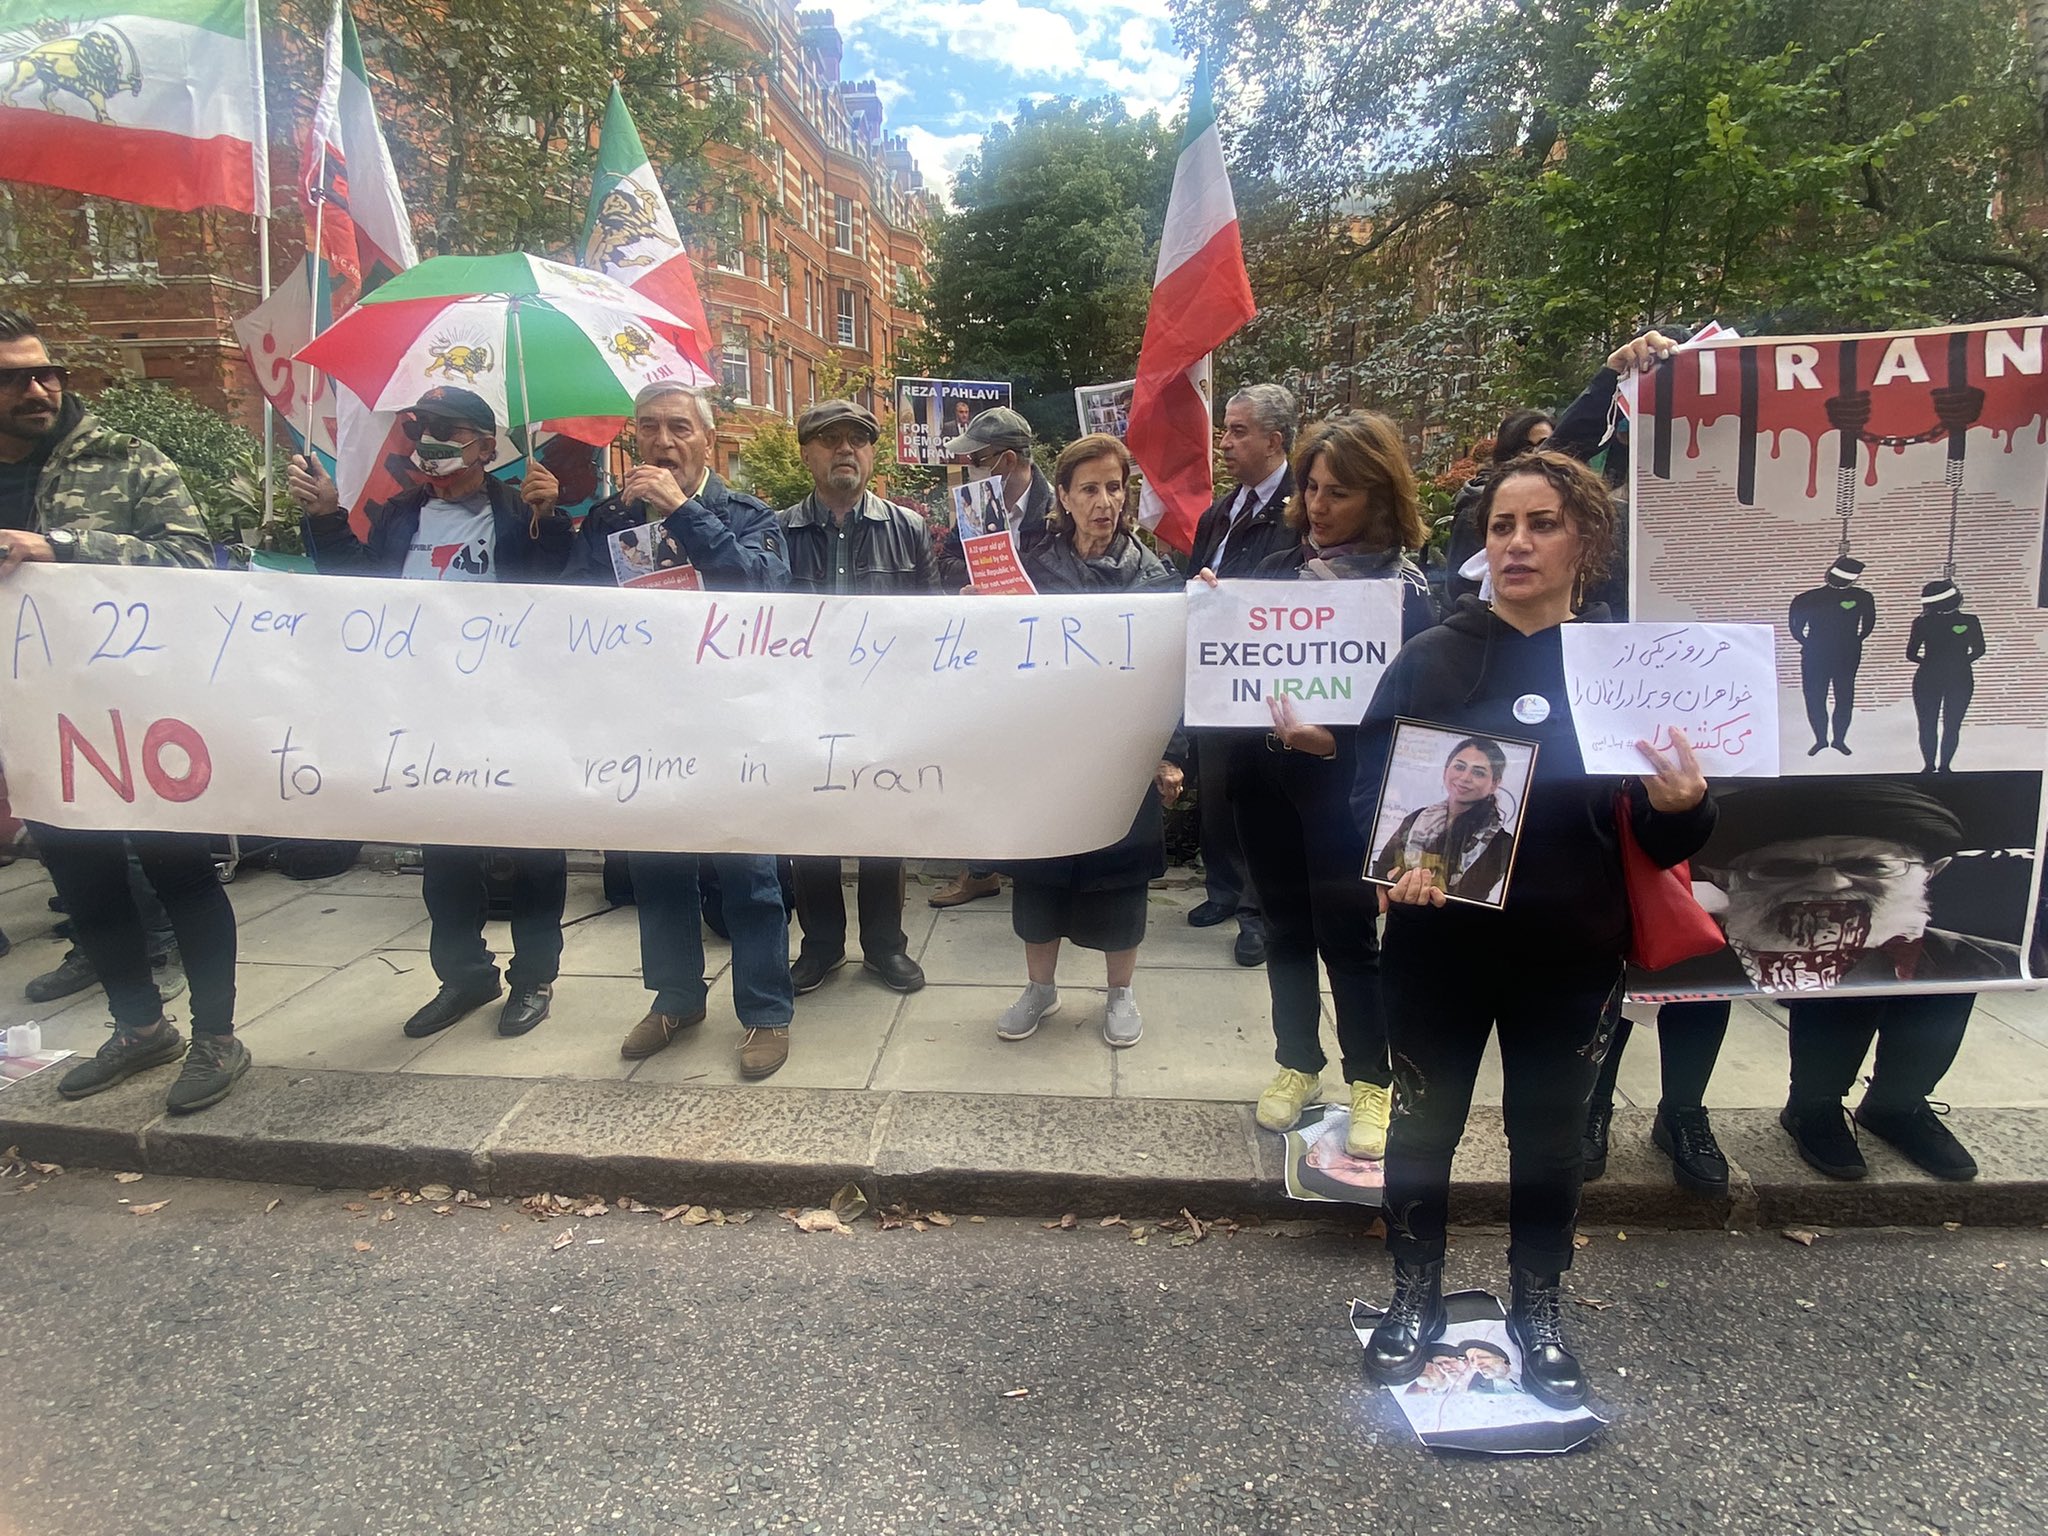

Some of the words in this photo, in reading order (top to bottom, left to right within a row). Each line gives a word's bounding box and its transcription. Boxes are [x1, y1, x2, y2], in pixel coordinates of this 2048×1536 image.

[1699, 328, 2043, 395] IRAN
[902, 385, 937, 397] REZA
[942, 387, 999, 400] PAHLAVI
[903, 423, 929, 434] FOR
[903, 435, 957, 447] DEMOC
[903, 448, 919, 458] IN
[922, 448, 955, 459] IRAN
[1248, 606, 1335, 631] STOP
[13, 594, 52, 680] A
[87, 601, 167, 666] 22
[456, 602, 535, 674] girl
[849, 611, 896, 687] by
[932, 617, 978, 672] the
[1200, 640, 1386, 667] EXECUTION
[1232, 678, 1261, 702] IN
[1274, 676, 1352, 702] IRAN
[58, 708, 213, 804] NO
[271, 726, 322, 800] to
[372, 728, 515, 795] Islamic
[583, 747, 698, 804] regime
[740, 753, 769, 784] in
[813, 733, 943, 794] Iran
